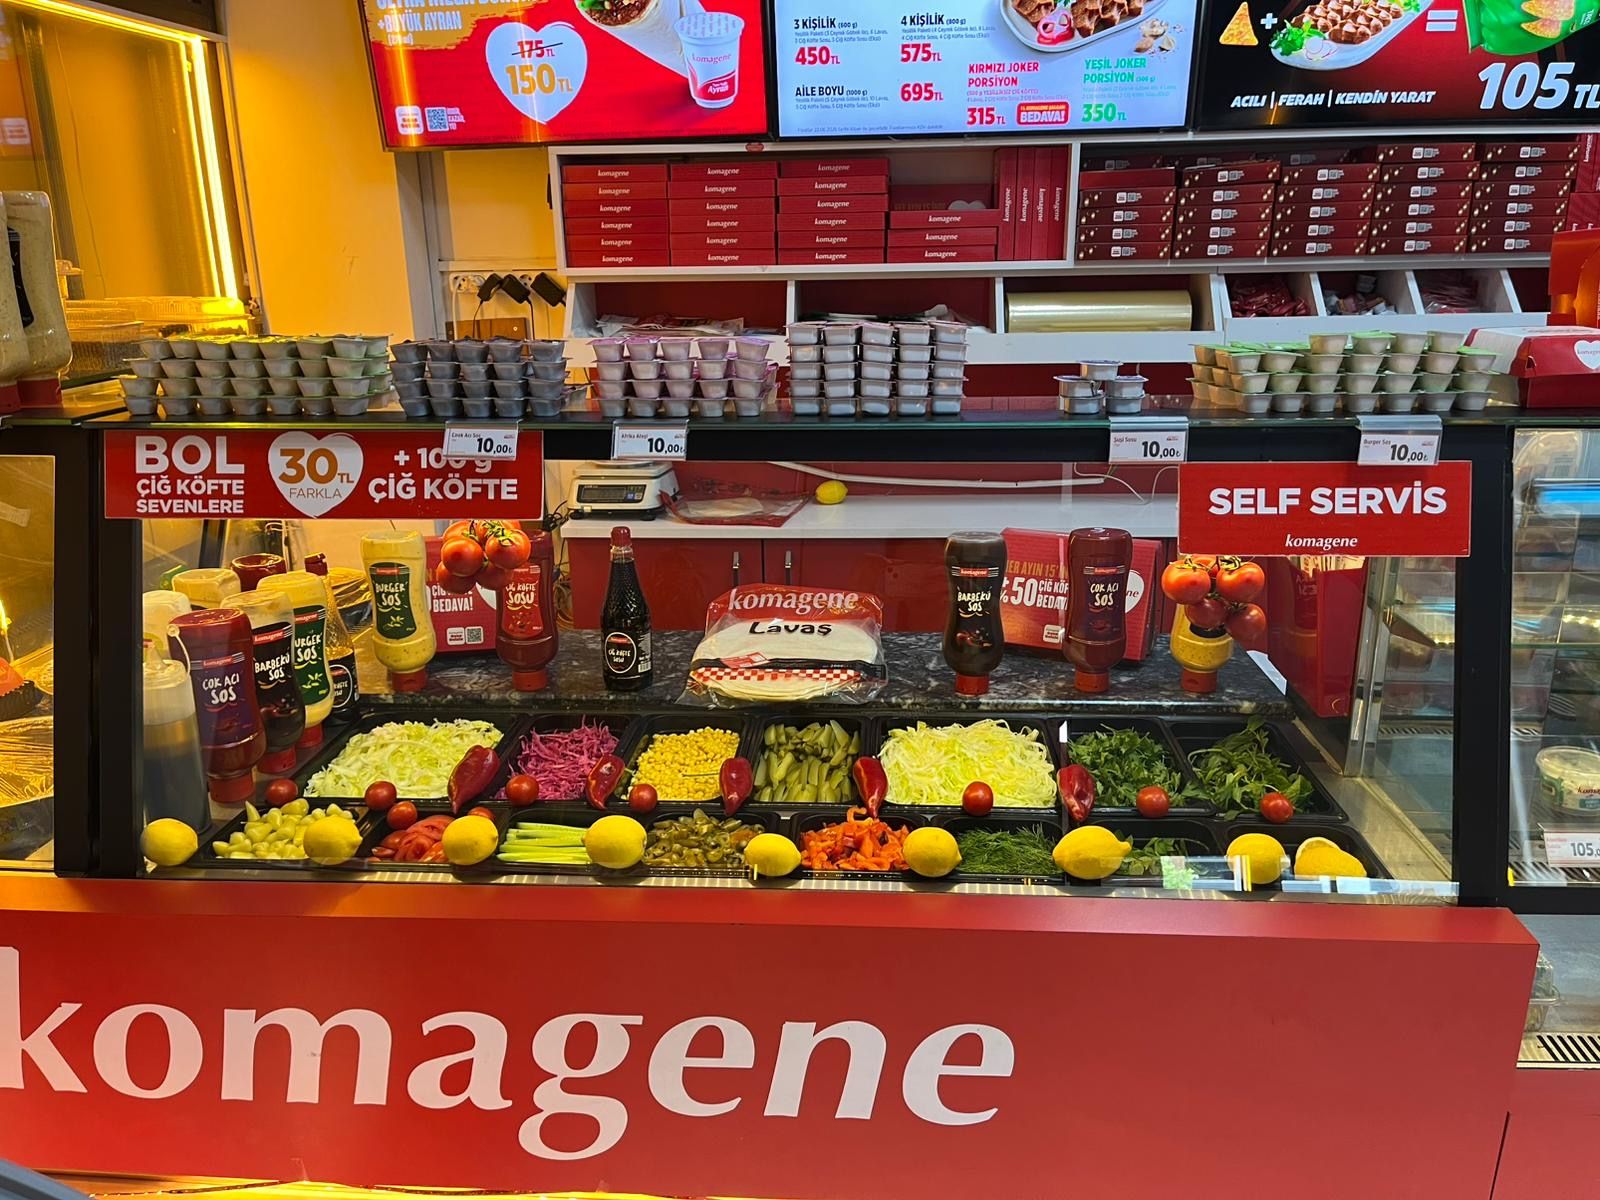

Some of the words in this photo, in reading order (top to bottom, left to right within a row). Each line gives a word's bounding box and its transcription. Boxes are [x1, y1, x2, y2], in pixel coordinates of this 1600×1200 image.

[424, 11, 463, 31] AYRAN
[794, 19, 800, 29] 3
[802, 16, 836, 30] KİŞİLİK
[901, 16, 907, 26] 4
[910, 13, 944, 27] KİŞİLİK
[968, 63, 1005, 74] KIRMIZI
[1007, 62, 1039, 73] JOKER
[1084, 57, 1112, 70] YEŞİL
[1114, 58, 1146, 69] JOKER
[968, 75, 1018, 87] PORSİYON
[1083, 71, 1134, 84] PORSİYON
[795, 85, 816, 96] AİLE
[818, 86, 844, 96] BOYU
[1478, 62, 1575, 110] 105
[1231, 96, 1267, 108] ACILI
[1278, 93, 1325, 106] FERAH
[1335, 90, 1389, 104] KENDİN
[1390, 91, 1436, 103] YARAT
[1020, 111, 1065, 123] BEDAVA!
[597, 169, 629, 178] komagene
[707, 167, 739, 176] komagene
[705, 185, 736, 193] komagene
[815, 181, 847, 190] komagene
[600, 204, 631, 212] komagene
[706, 202, 738, 211] komagene
[817, 200, 849, 208] komagene
[707, 219, 738, 228] komagene
[814, 217, 846, 226] komagene
[928, 214, 961, 224] komagene
[601, 221, 632, 230] komagene
[601, 238, 632, 247] komagene
[706, 236, 738, 245] komagene
[816, 235, 847, 244] komagene
[925, 232, 958, 242] komagene
[602, 255, 633, 263] komagene
[708, 253, 739, 262] komagene
[815, 252, 847, 261] komagene
[924, 249, 957, 259] komagene
[136, 435, 245, 474] BOL
[136, 475, 171, 497] ÇİĞ
[177, 475, 245, 495] KÖFTE
[368, 472, 416, 503] ÇİĞ
[423, 473, 518, 500] KÖFTE
[289, 488, 342, 499] FARKLA
[1208, 487, 1301, 515] SELF
[1309, 481, 1447, 515] SERVİS
[136, 499, 244, 513] SEVENLERE
[1285, 534, 1358, 550] komagene
[1007, 560, 1020, 574] ER
[1021, 561, 1043, 576] AYIN
[1038, 578, 1052, 593] ÇİĞ
[1053, 579, 1069, 594] KÖF
[381, 593, 401, 606] SOS
[508, 592, 534, 604] SOSU
[728, 588, 859, 615] komagene
[1094, 593, 1113, 606] SOS
[433, 597, 473, 612] BEDAVA!
[968, 602, 982, 612] SOS
[748, 622, 832, 637] Lavaş
[294, 633, 321, 648] URGER
[296, 646, 317, 662] SOS
[268, 667, 285, 681] SOS
[210, 686, 237, 705] SOS
[0, 946, 1015, 1161] komagene
